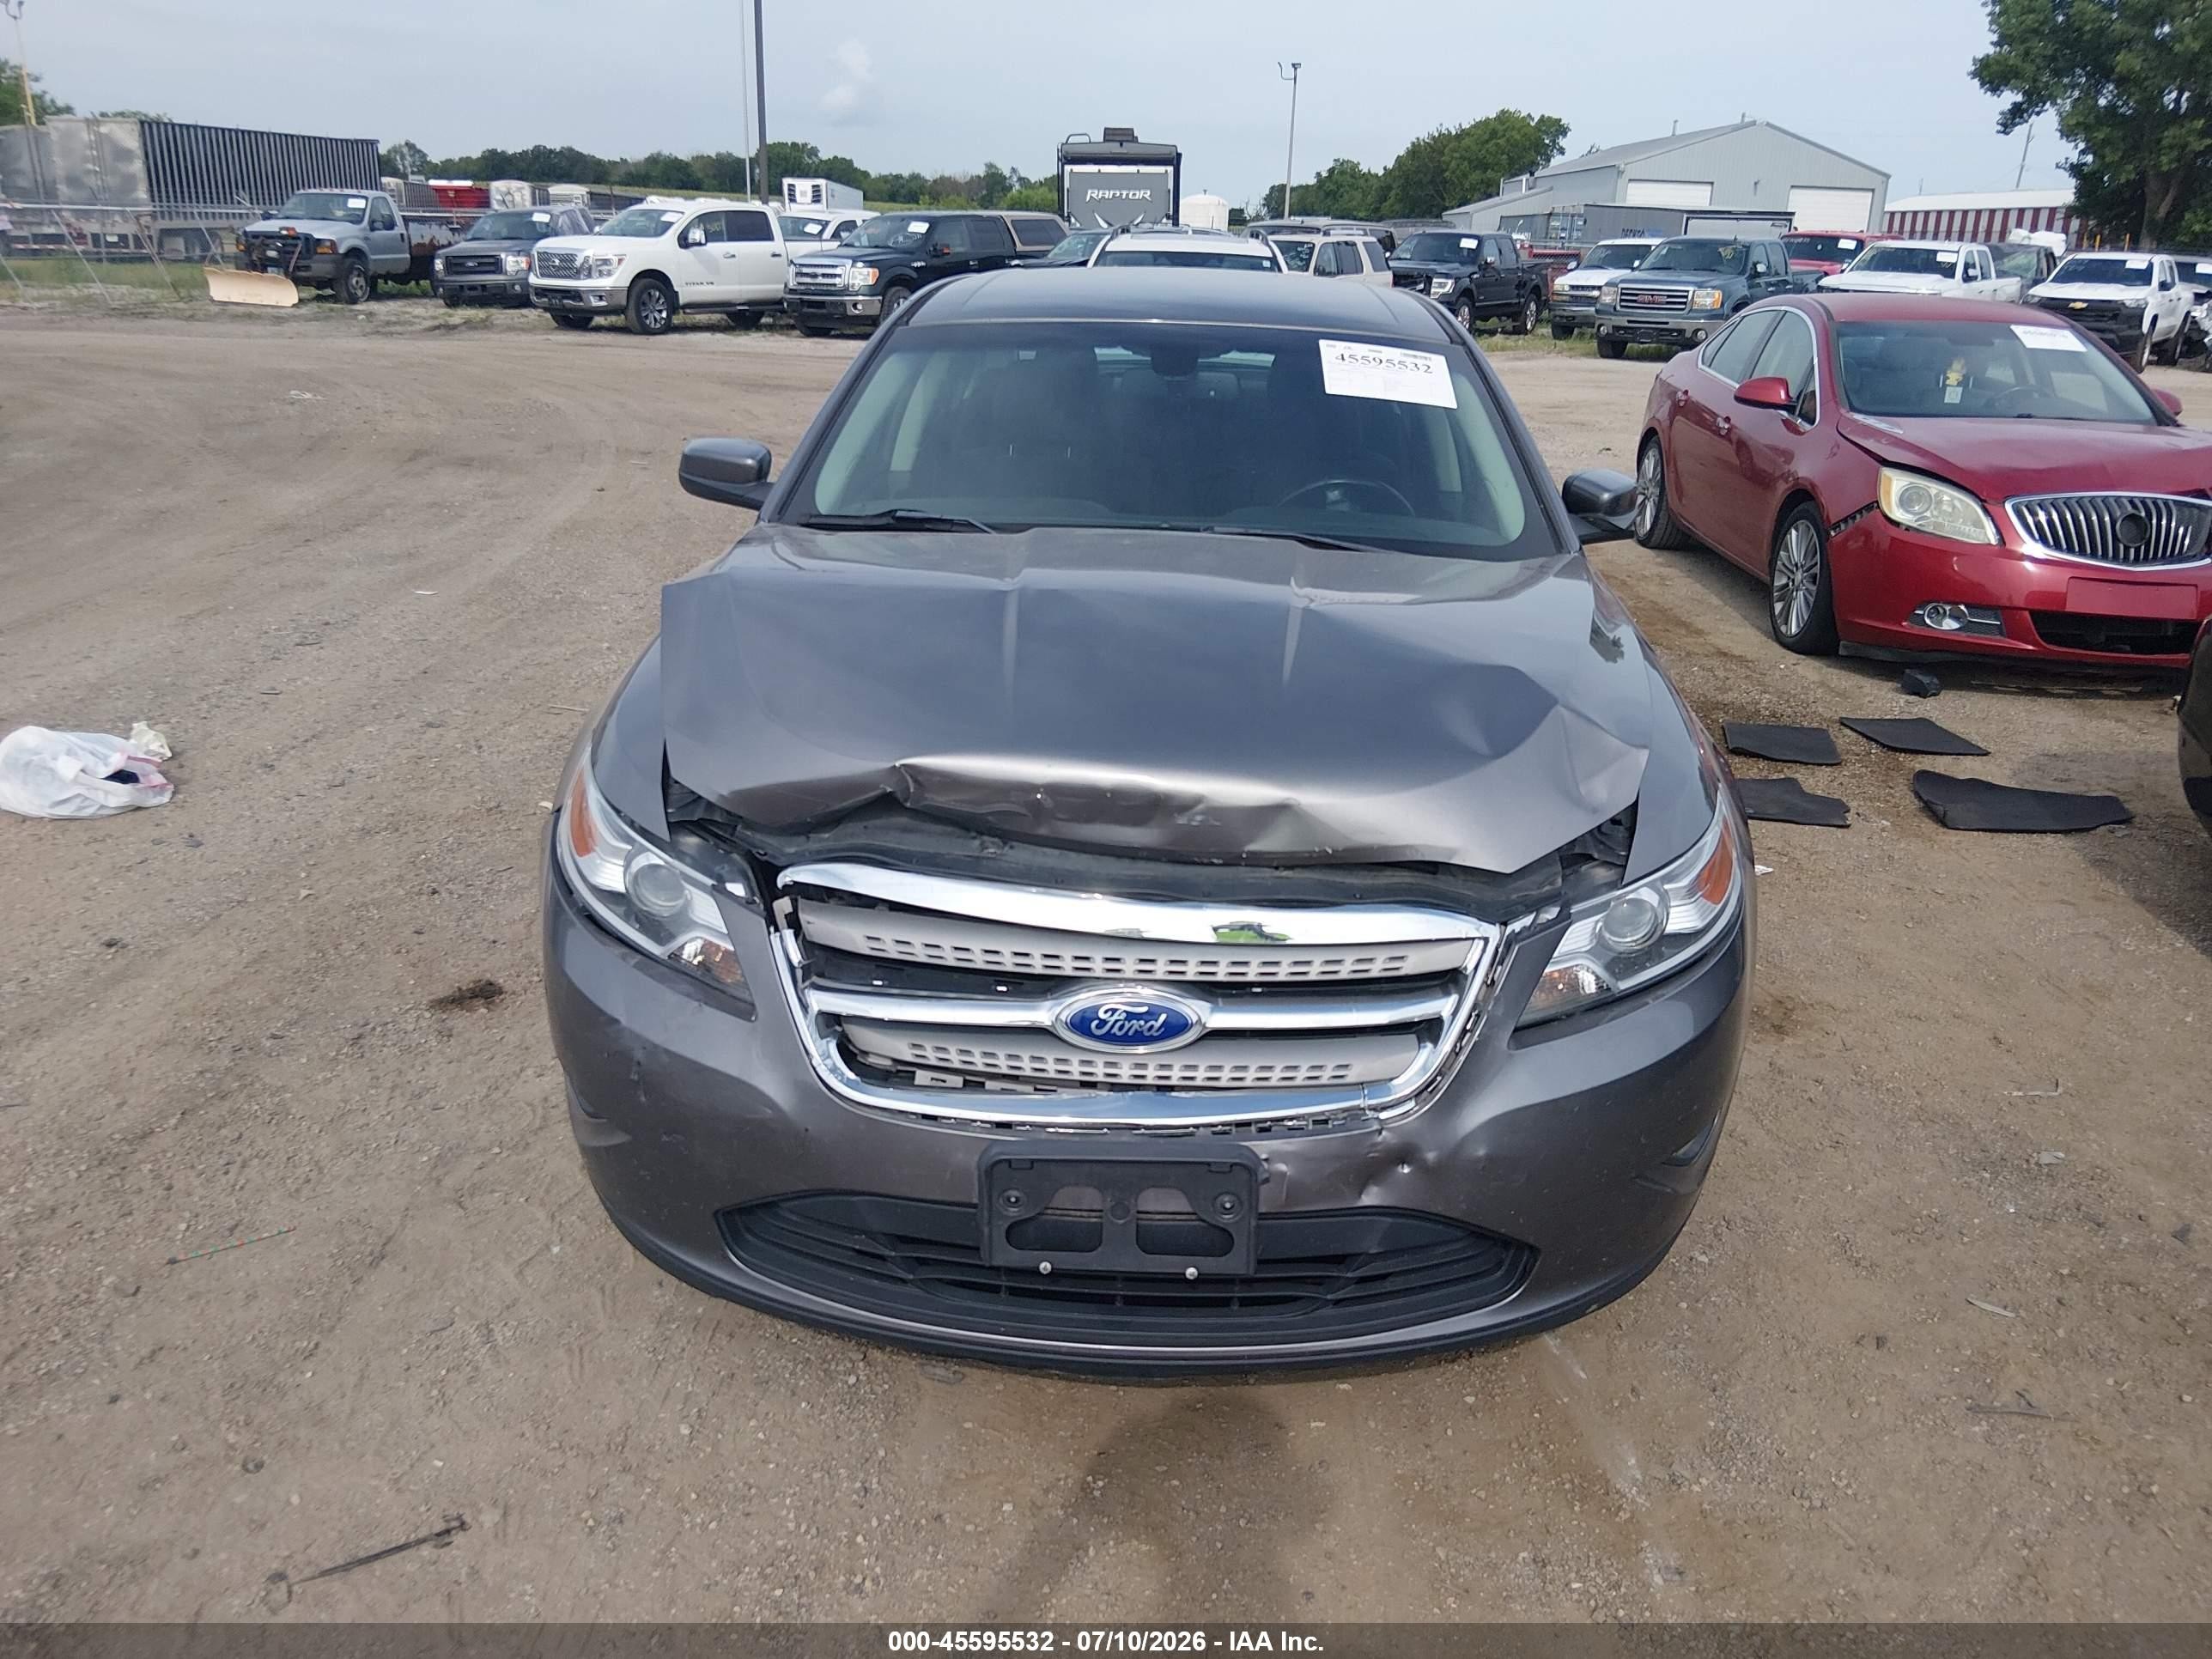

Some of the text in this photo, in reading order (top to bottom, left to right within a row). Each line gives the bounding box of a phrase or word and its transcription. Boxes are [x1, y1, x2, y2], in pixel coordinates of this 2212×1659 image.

[1085, 189, 1152, 203] RAPTOR
[1335, 353, 1433, 374] 45595532
[1091, 1003, 1168, 1036] Ford
